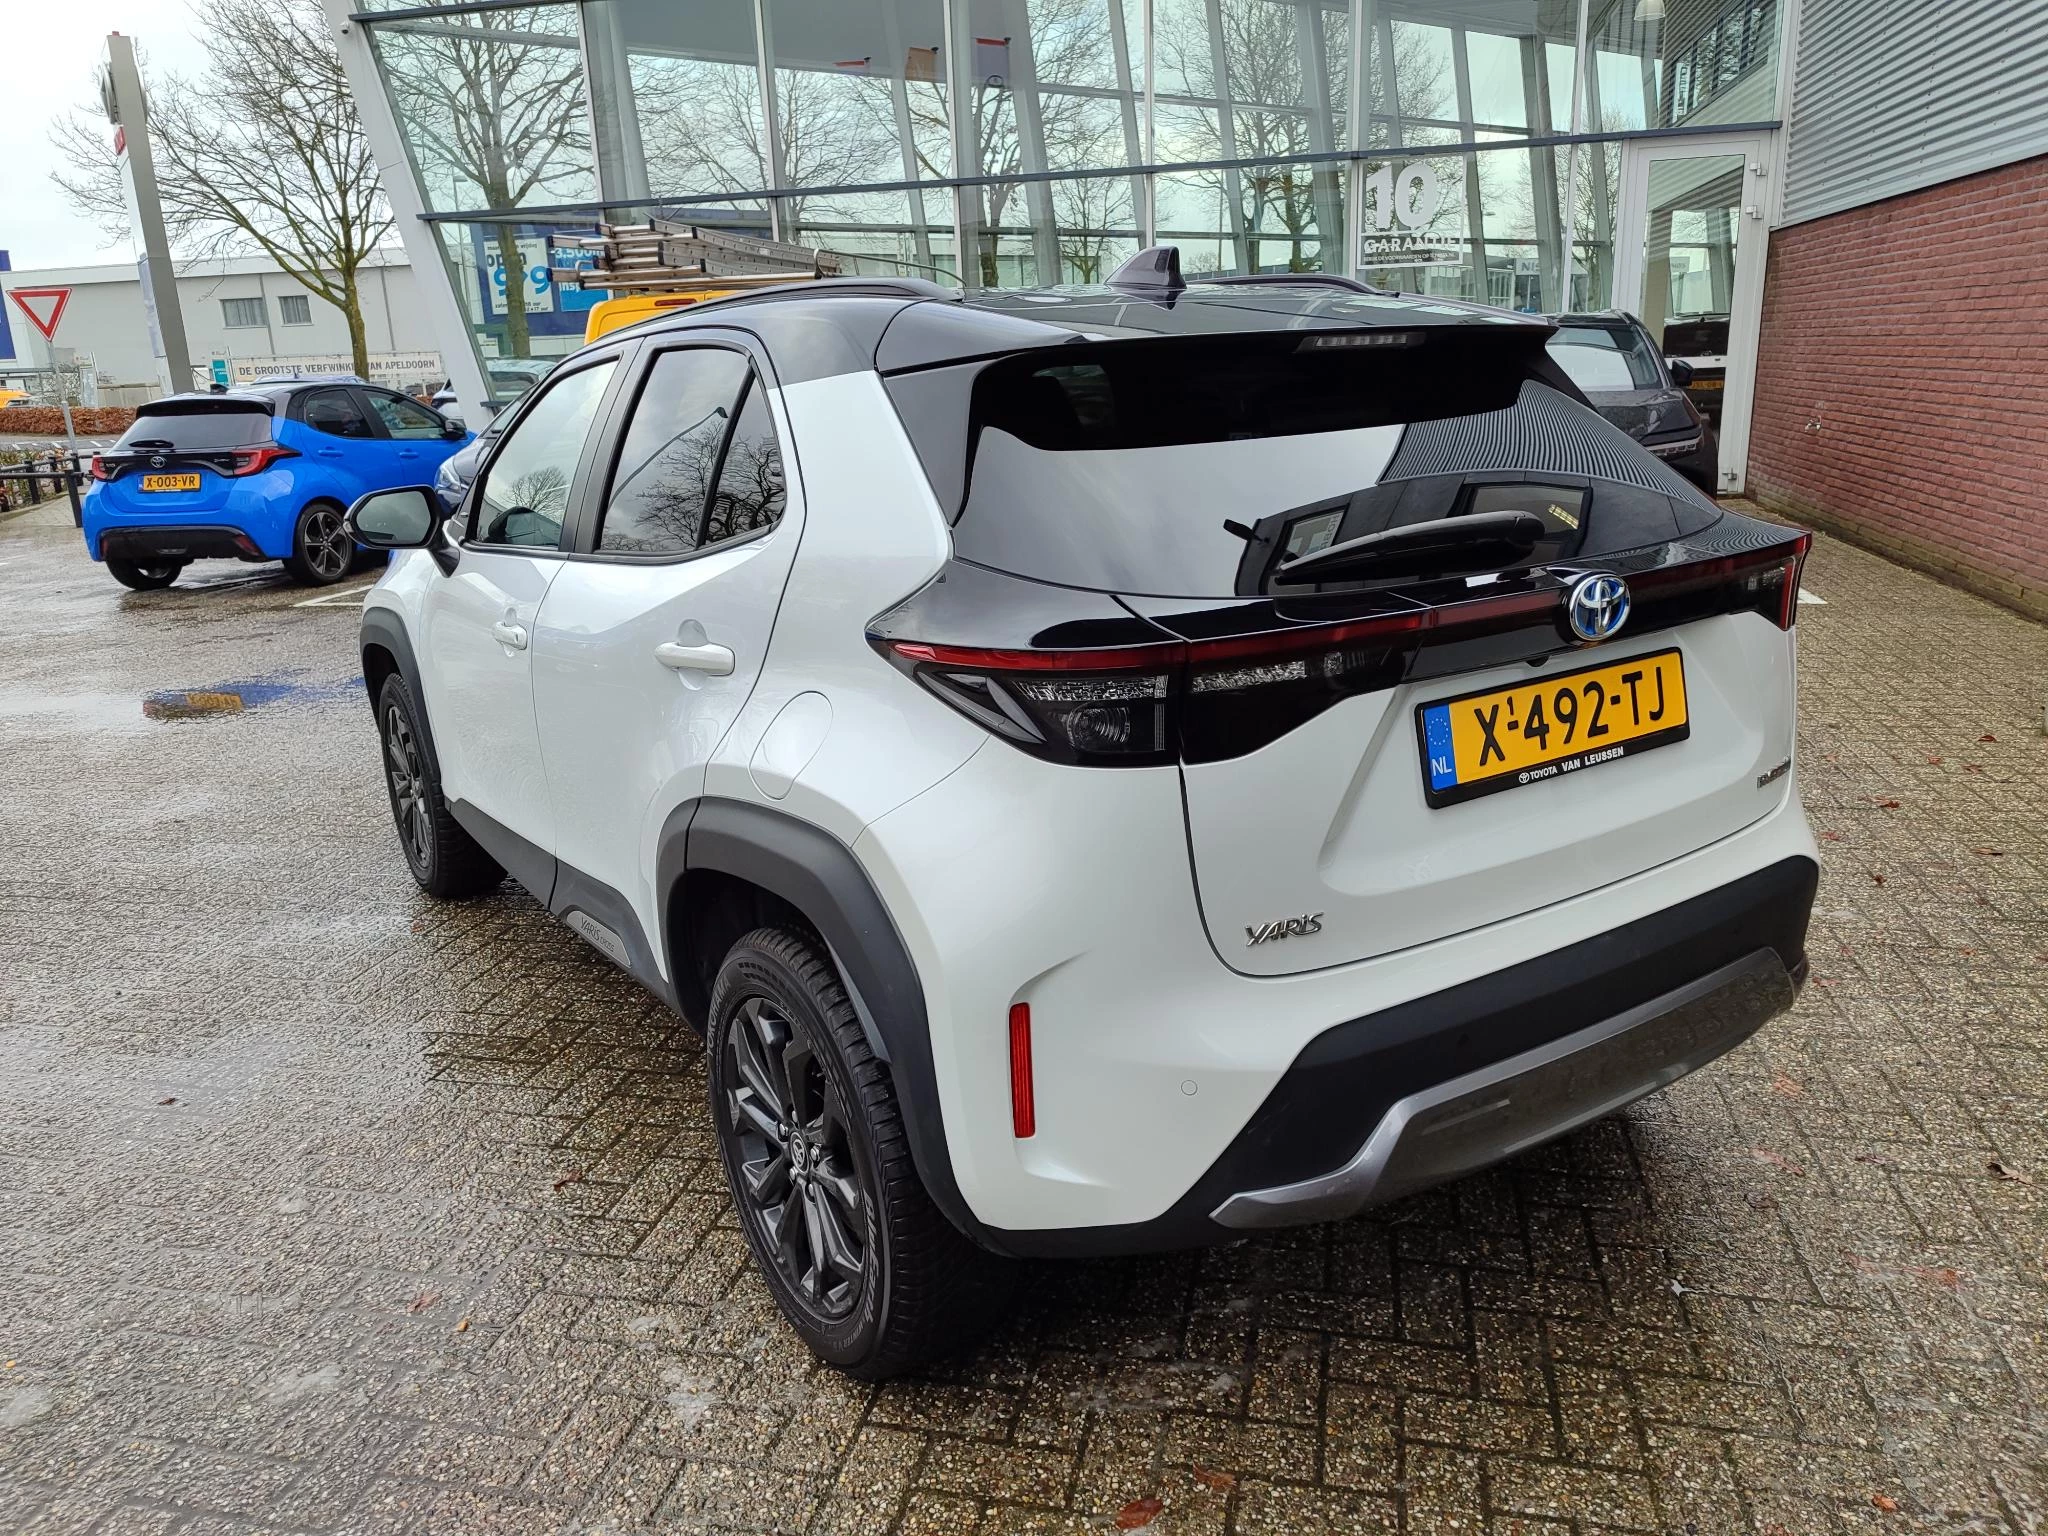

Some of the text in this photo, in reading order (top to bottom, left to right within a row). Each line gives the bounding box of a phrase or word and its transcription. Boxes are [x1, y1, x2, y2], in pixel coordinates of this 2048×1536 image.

[1366, 161, 1437, 231] 10
[1364, 236, 1457, 253] GARANTIE
[530, 265, 551, 294] 9
[239, 366, 253, 376] DE
[254, 364, 303, 376] GROOTSTE
[305, 362, 356, 374] VERFWINK
[367, 361, 383, 371] AN
[385, 359, 436, 370] APELDOORN
[146, 475, 196, 488] X-003-VR
[1431, 757, 1453, 777] NL
[1530, 746, 1625, 781] TOYOTA VAN LEUSSEN
